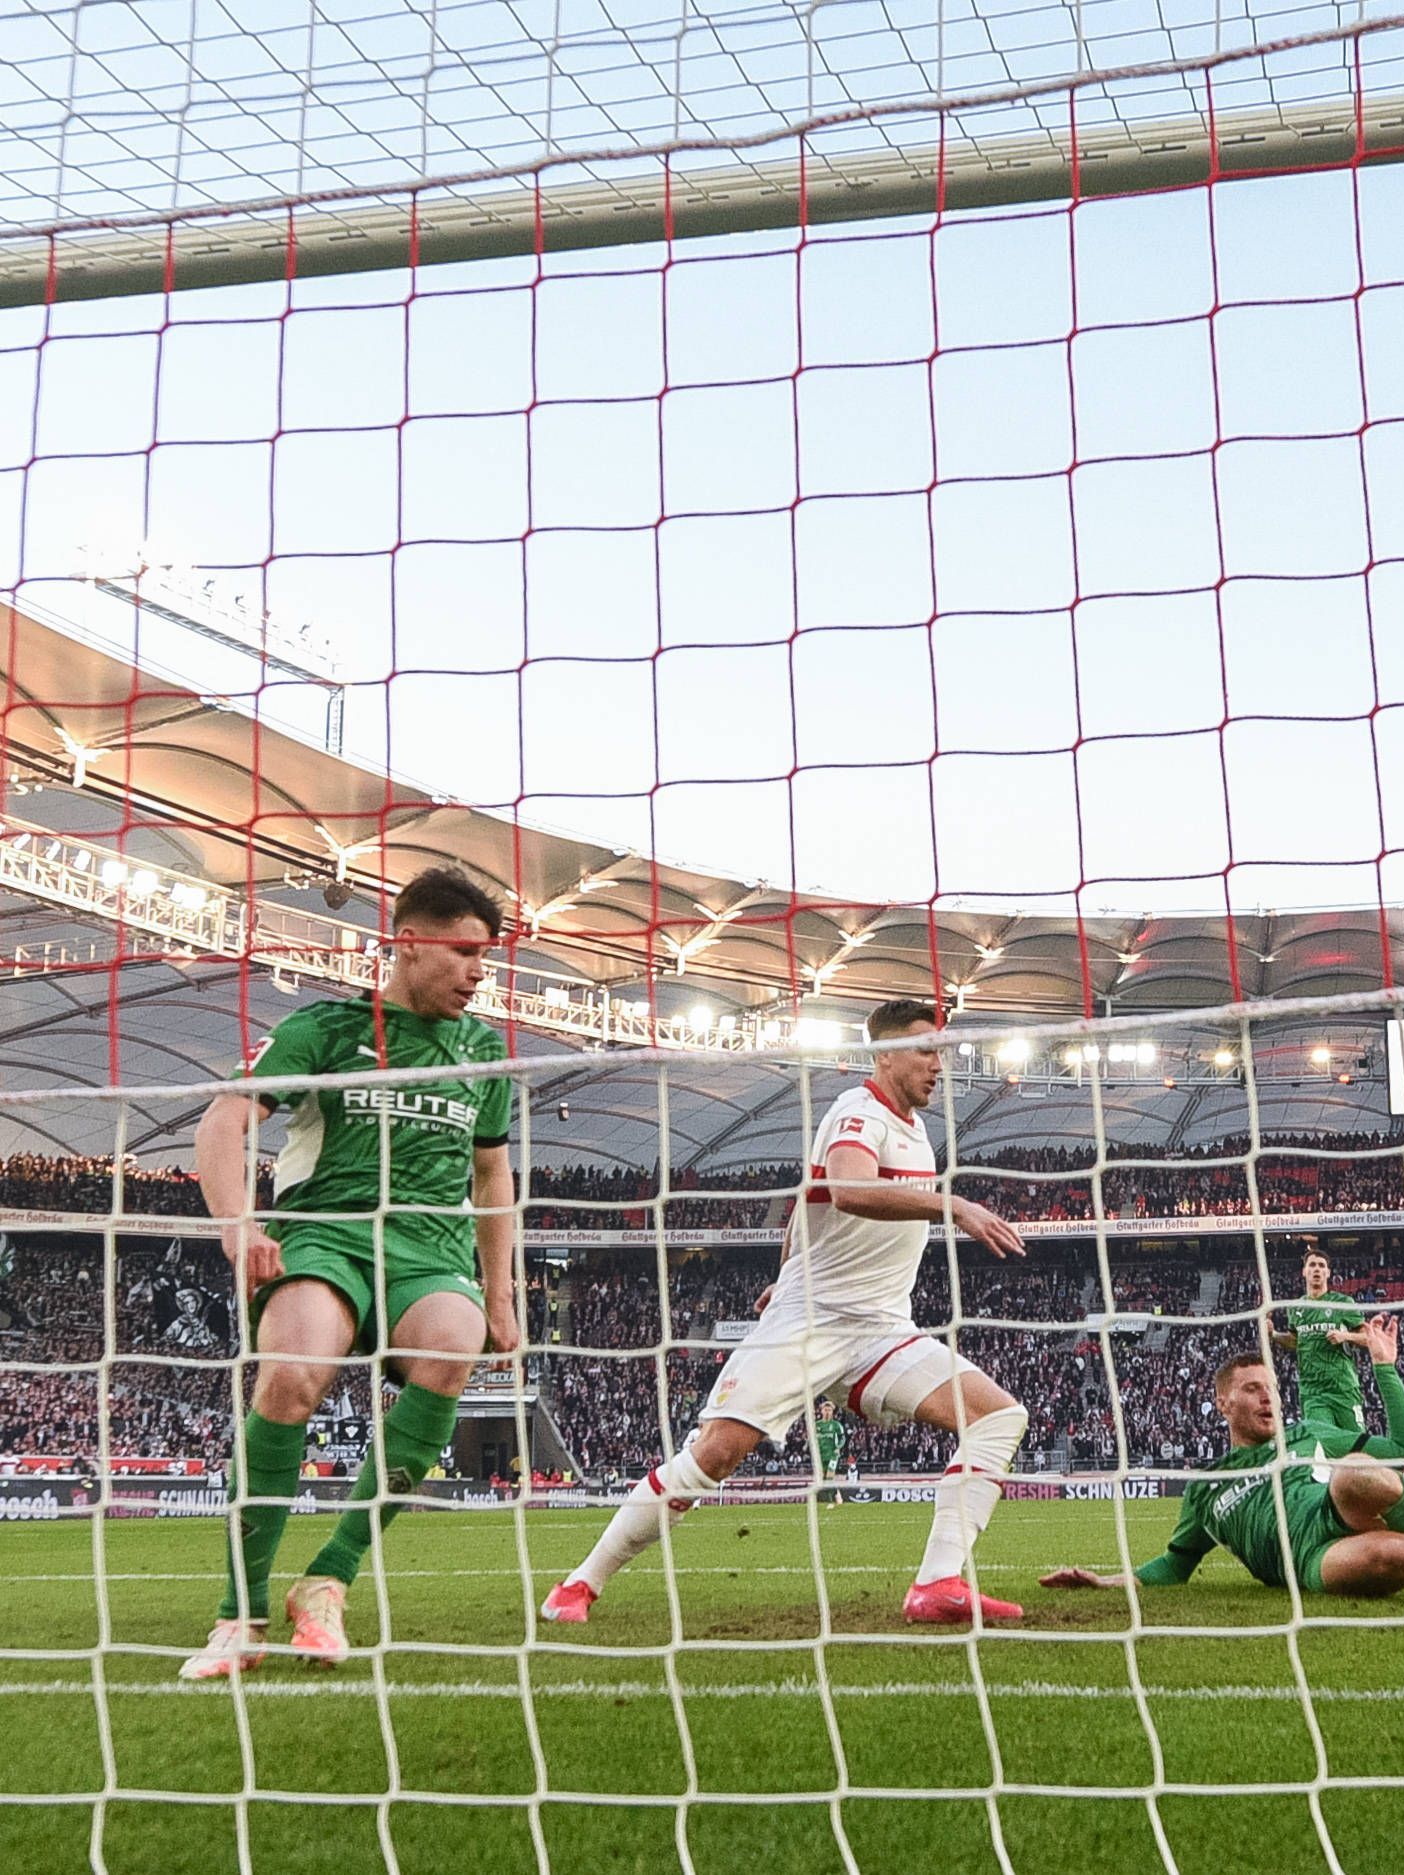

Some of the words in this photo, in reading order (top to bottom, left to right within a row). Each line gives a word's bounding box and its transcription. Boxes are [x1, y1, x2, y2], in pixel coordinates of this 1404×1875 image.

[343, 1089, 479, 1126] REUTER
[523, 1231, 565, 1243] tuttgarter
[0, 1488, 58, 1519] osch
